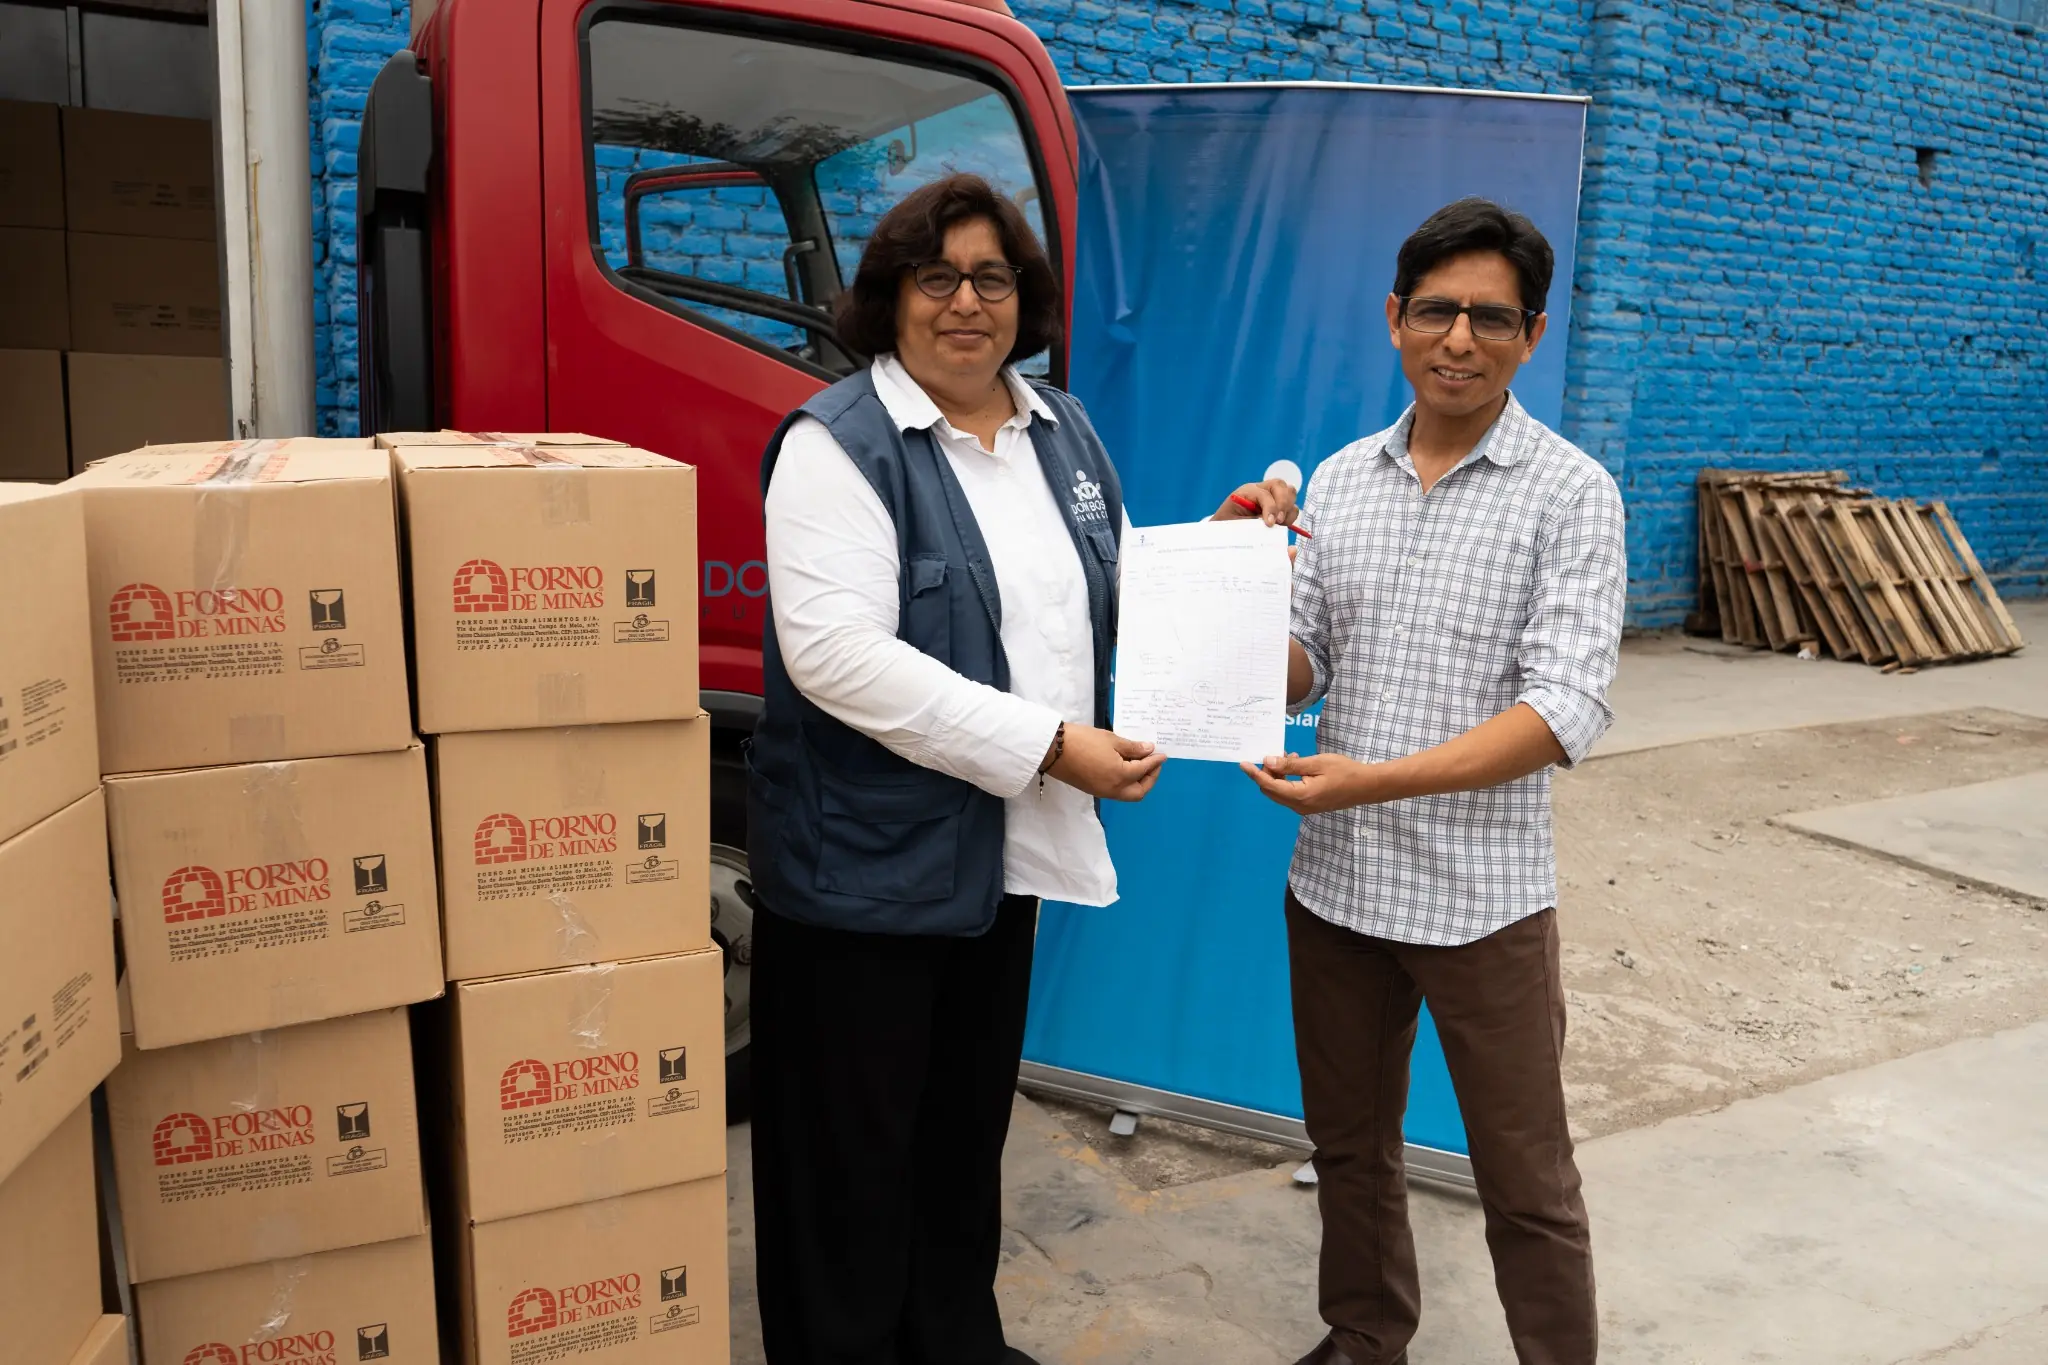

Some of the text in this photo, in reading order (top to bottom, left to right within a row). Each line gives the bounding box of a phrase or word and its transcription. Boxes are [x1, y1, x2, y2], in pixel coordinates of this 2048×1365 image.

[510, 566, 603, 591] FORNO
[174, 587, 284, 617] FORNO
[511, 592, 604, 611] DE MINAS
[178, 615, 286, 638] DE MINAS
[528, 813, 617, 842] FORNO
[529, 837, 617, 860] DE MINAS
[224, 857, 329, 895] FORNO
[228, 883, 331, 914] DE MINAS
[552, 1050, 638, 1085] FORNO
[554, 1073, 639, 1102] DE MINAS
[212, 1105, 313, 1140] FORNO
[215, 1129, 315, 1159] DE MINAS
[558, 1272, 640, 1310] FORNO
[559, 1293, 641, 1326] DE MINAS
[239, 1330, 335, 1363] FORNO
